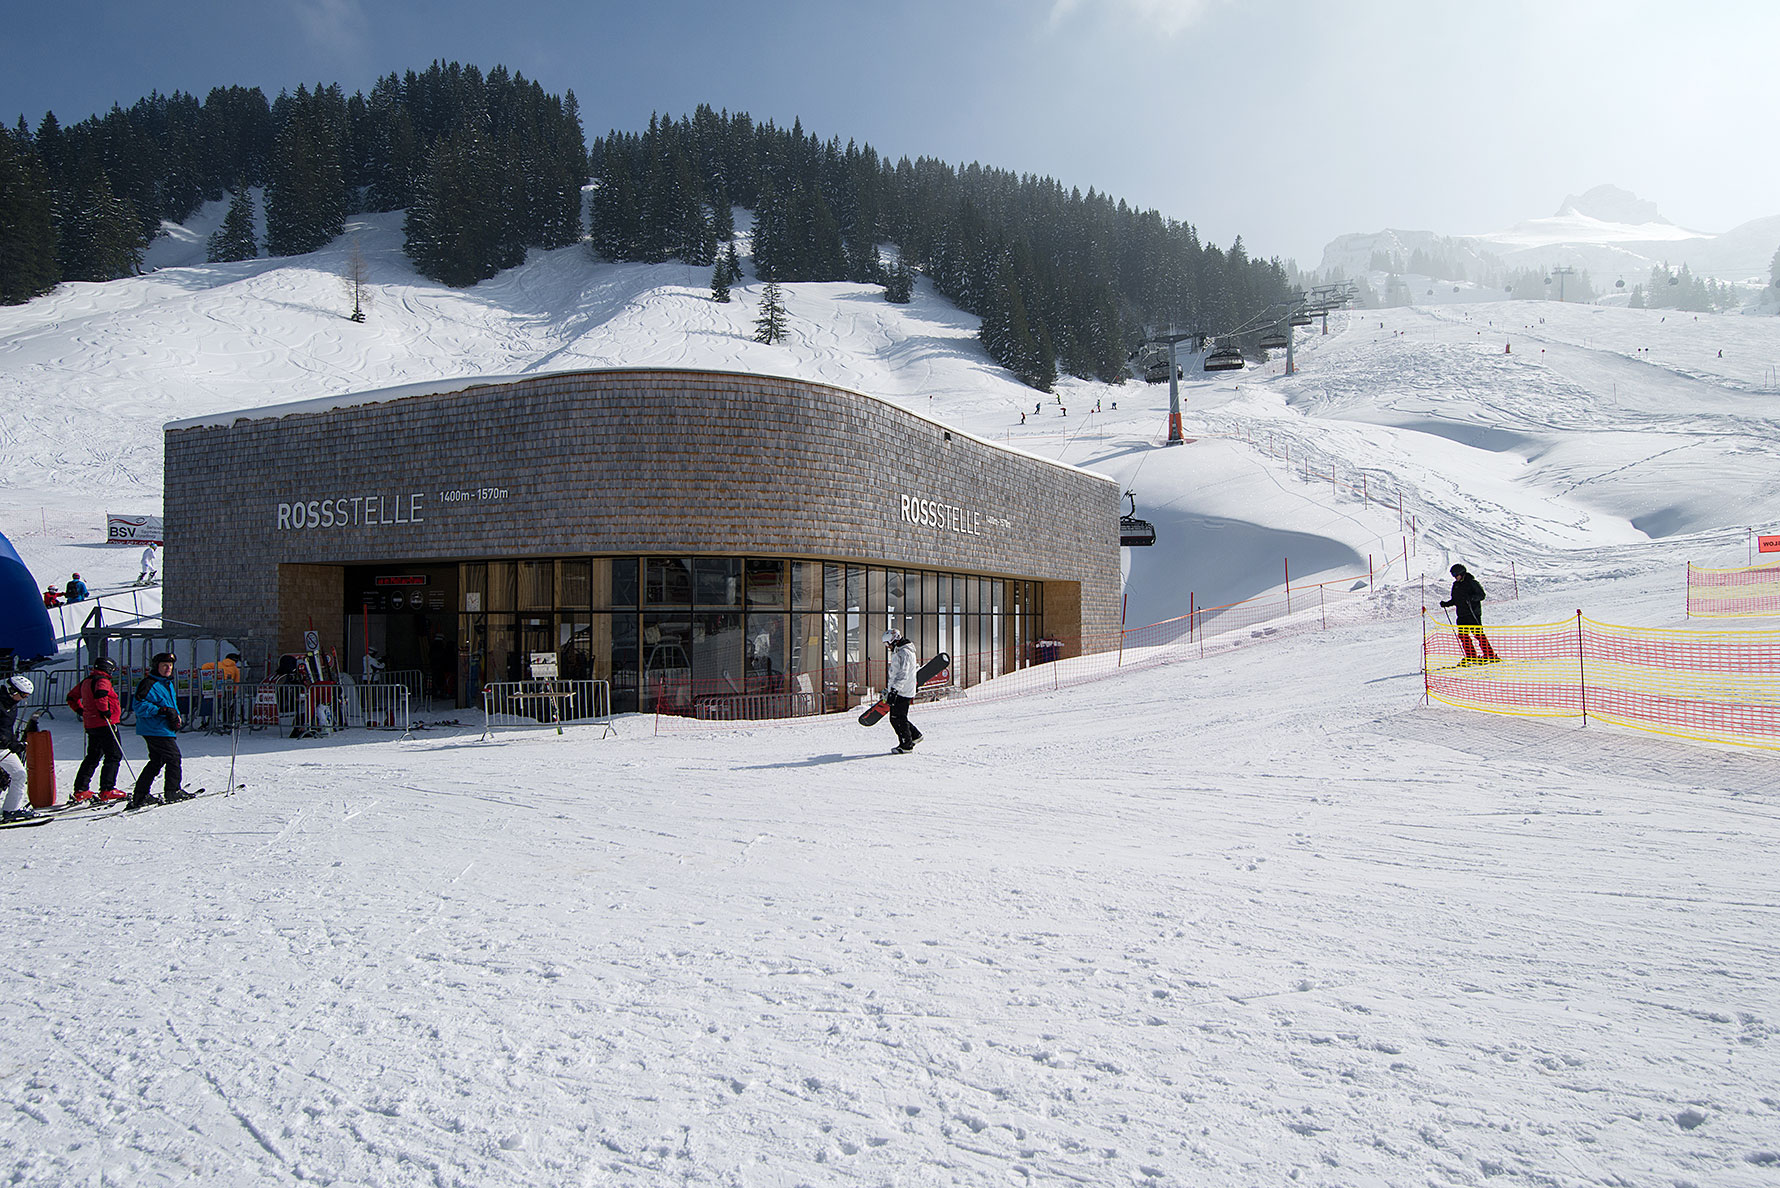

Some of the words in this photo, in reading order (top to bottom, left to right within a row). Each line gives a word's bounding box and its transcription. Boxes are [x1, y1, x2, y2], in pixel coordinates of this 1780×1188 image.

[277, 493, 424, 530] ROSSSTELLE
[901, 494, 981, 536] ROSSSTELLE
[109, 526, 137, 538] BSV
